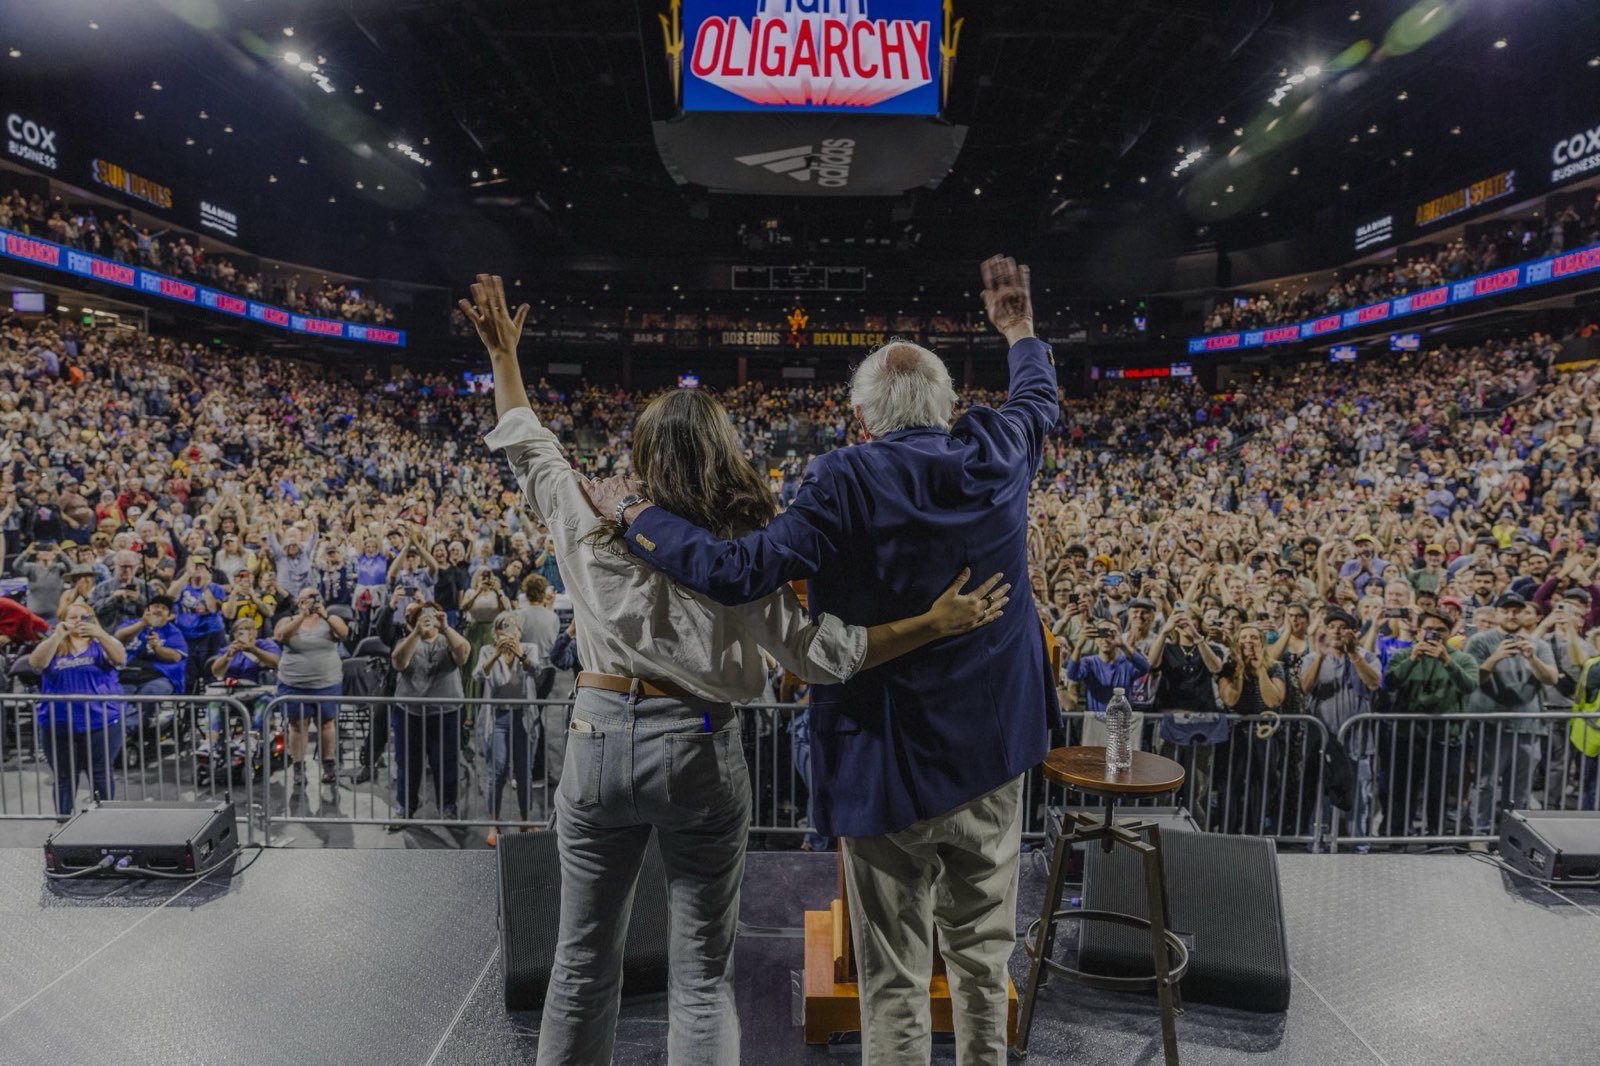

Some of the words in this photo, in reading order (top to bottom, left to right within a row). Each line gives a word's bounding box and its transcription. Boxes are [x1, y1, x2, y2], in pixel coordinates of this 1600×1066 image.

[691, 16, 931, 81] OLIGARCHY
[7, 113, 56, 153] COX
[1553, 125, 1600, 165] COX
[8, 140, 57, 169] BUSINESS
[810, 138, 855, 187] adidas
[93, 159, 129, 191] SUN
[722, 332, 744, 345] DOS
[746, 332, 780, 345] EQUIS
[813, 333, 848, 345] DEVIL
